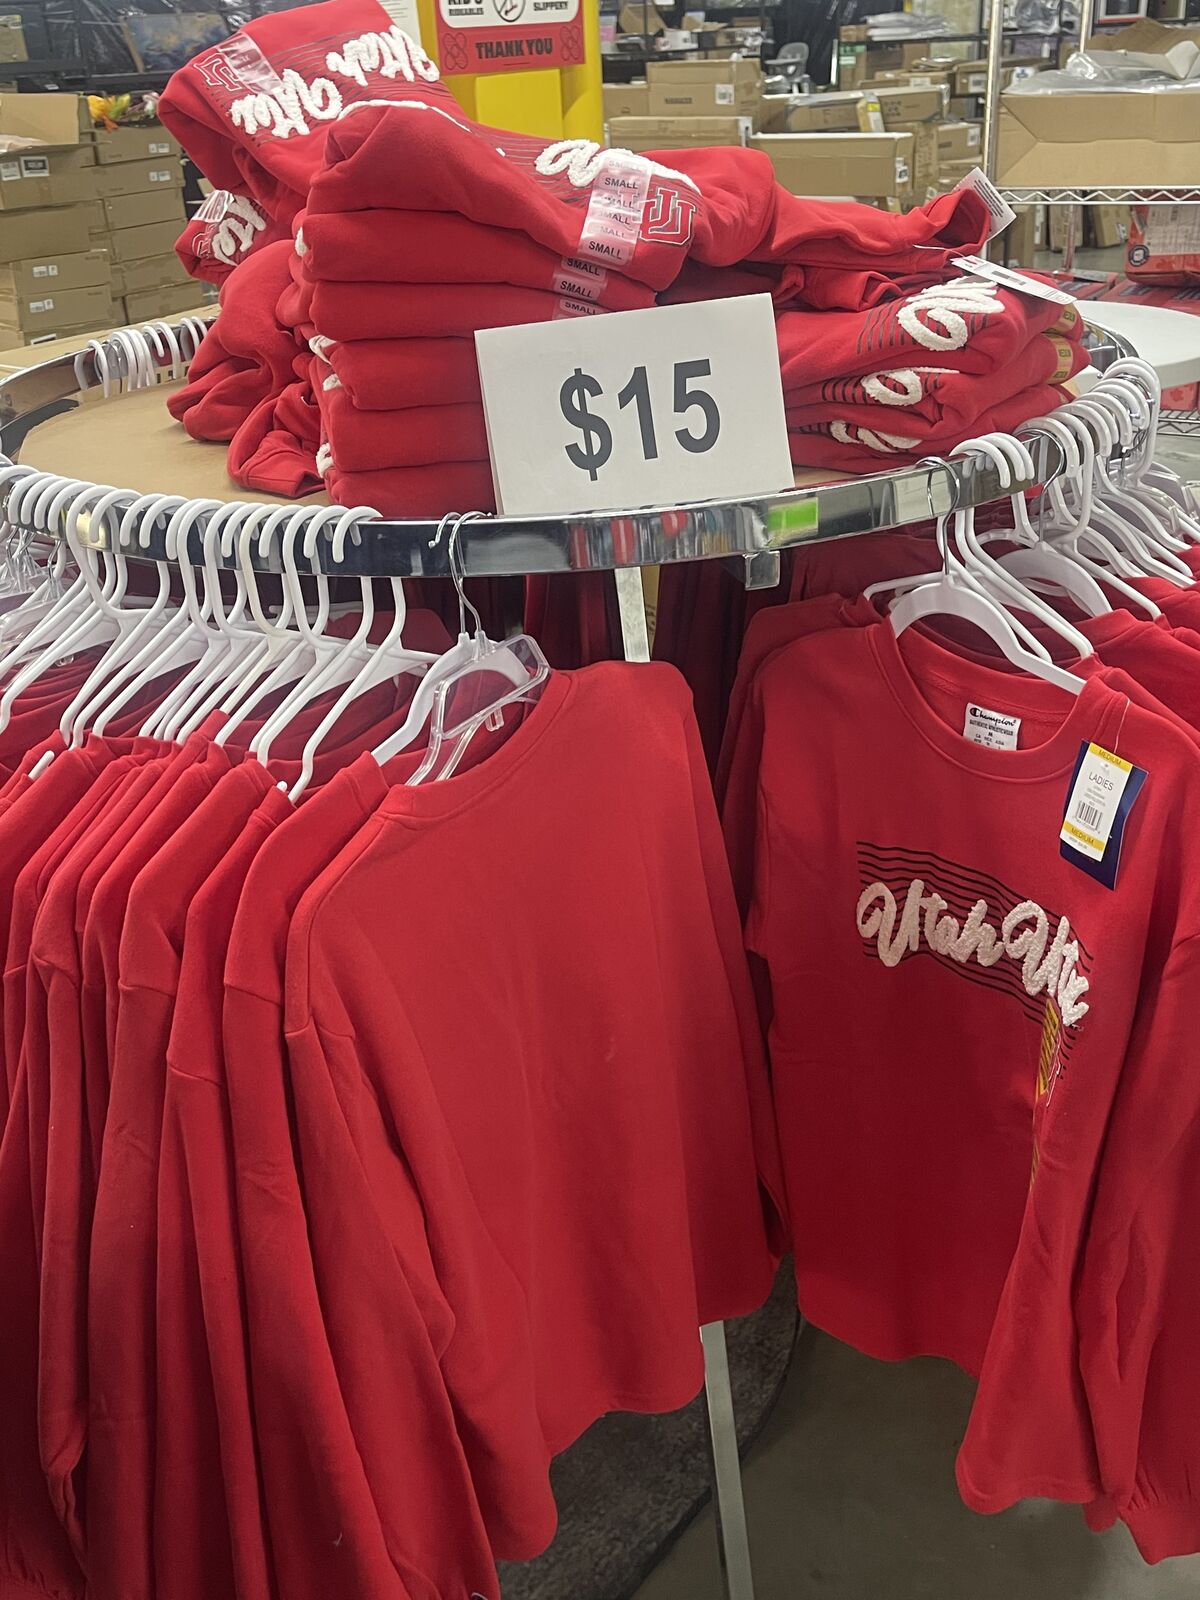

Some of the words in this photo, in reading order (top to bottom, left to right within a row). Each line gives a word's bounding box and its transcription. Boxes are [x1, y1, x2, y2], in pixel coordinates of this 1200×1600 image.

[475, 39, 525, 59] THANK
[527, 37, 553, 55] YOU
[604, 177, 639, 190] SMALL
[588, 240, 623, 261] SMALL
[566, 257, 601, 277] SMALL
[559, 280, 594, 299] SMALL
[559, 358, 721, 482] $15
[969, 707, 1014, 727] Champion
[1099, 749, 1122, 765] MEDIUM
[1088, 771, 1114, 791] LADIES
[1071, 827, 1094, 846] MEDIUM
[856, 879, 1004, 967] Utah
